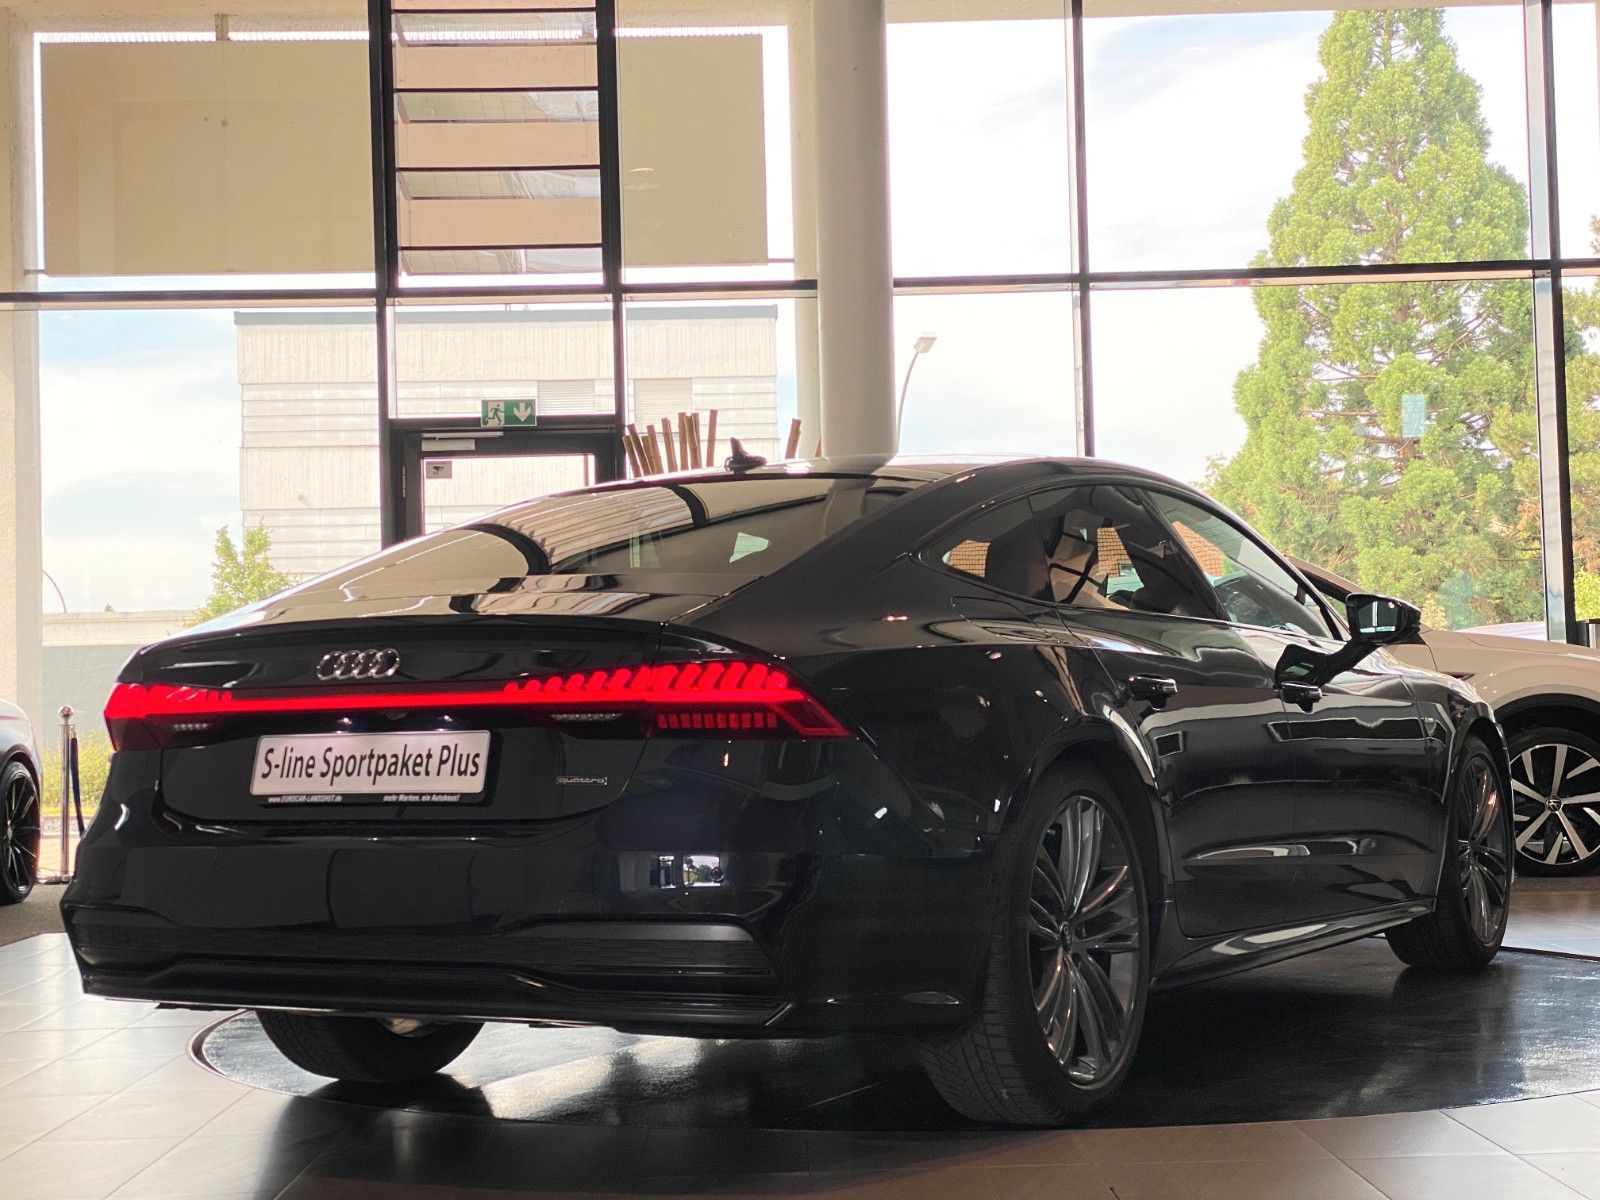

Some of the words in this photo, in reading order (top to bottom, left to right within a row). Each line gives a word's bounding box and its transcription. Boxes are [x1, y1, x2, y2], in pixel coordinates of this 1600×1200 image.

[261, 746, 316, 779] S-line
[319, 743, 433, 787] Sportpaket
[436, 743, 481, 777] Plus
